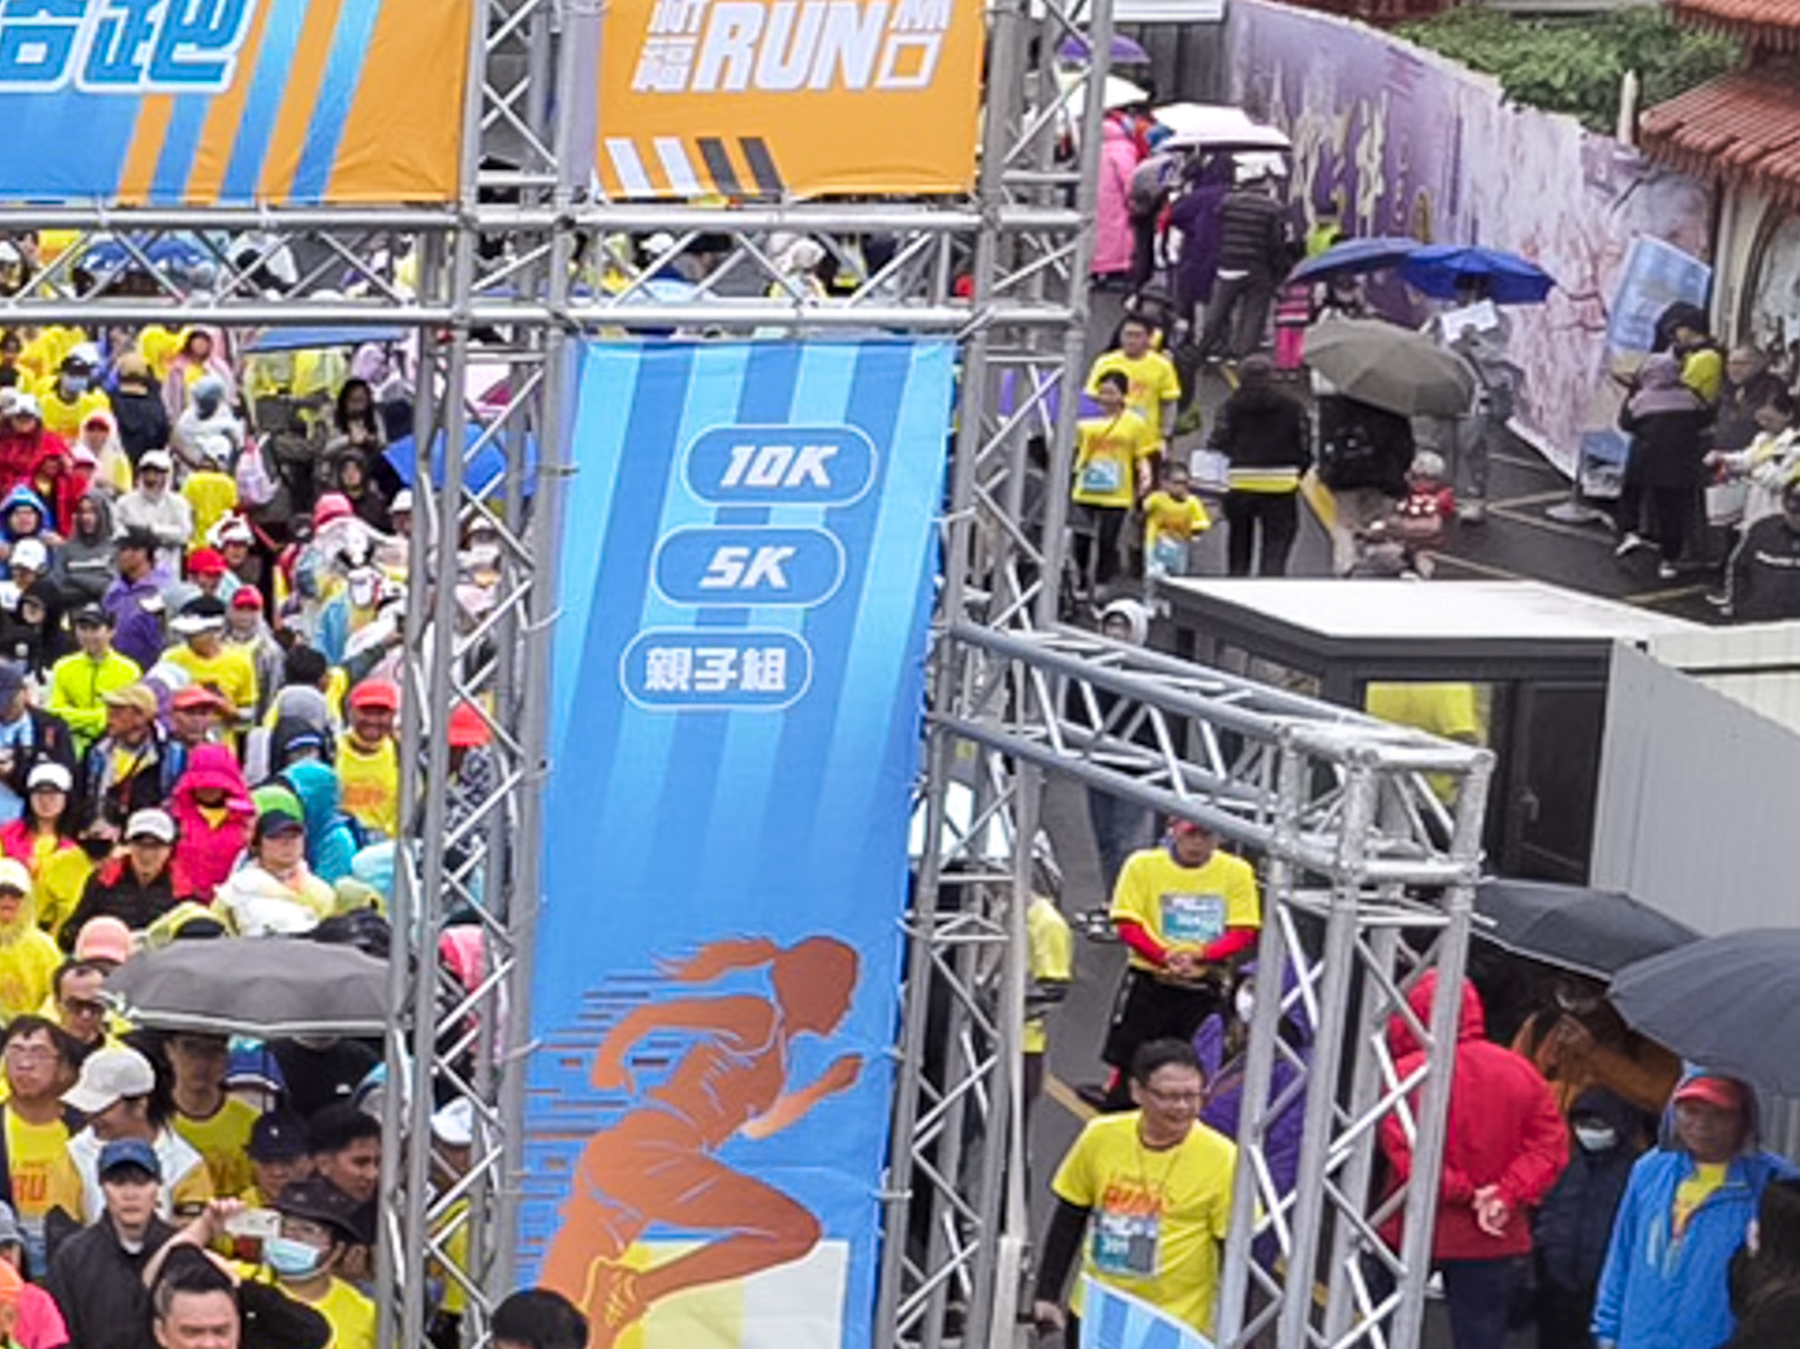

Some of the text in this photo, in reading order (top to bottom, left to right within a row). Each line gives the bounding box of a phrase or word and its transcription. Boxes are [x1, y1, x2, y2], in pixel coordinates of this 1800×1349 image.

[720, 445, 838, 487] 10K
[699, 546, 797, 589] 5K
[644, 648, 788, 691] 親子組
